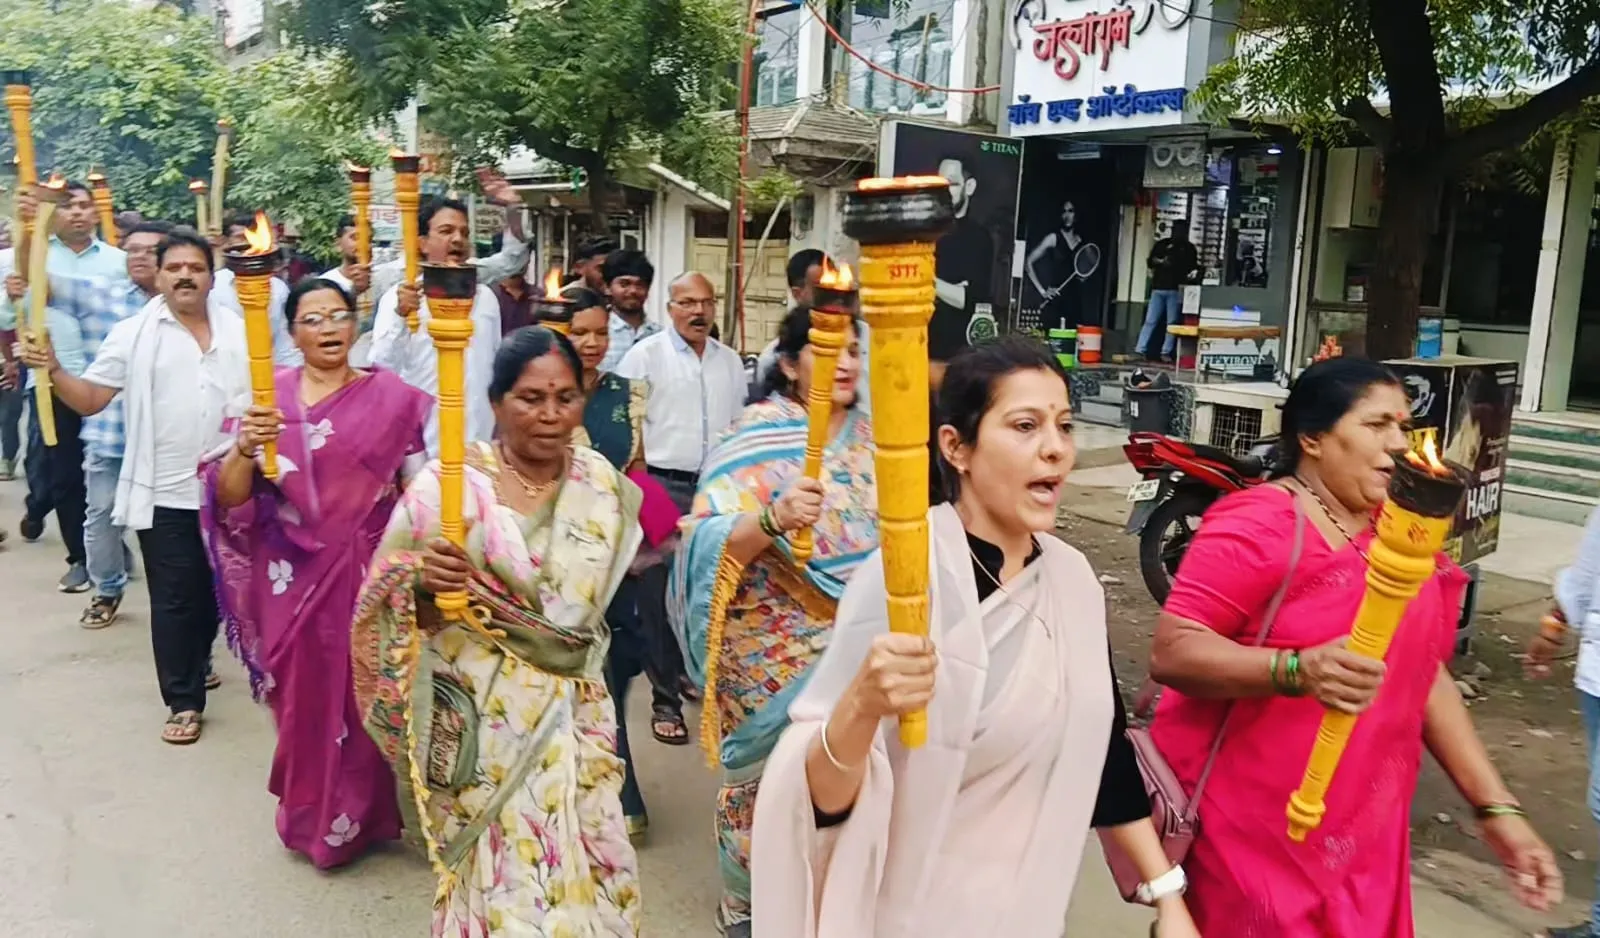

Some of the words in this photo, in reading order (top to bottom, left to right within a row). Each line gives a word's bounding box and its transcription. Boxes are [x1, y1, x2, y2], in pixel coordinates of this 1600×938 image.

[1007, 94, 1042, 125] वॉच
[992, 142, 1019, 156] TITAN
[1466, 482, 1501, 520] HAIR
